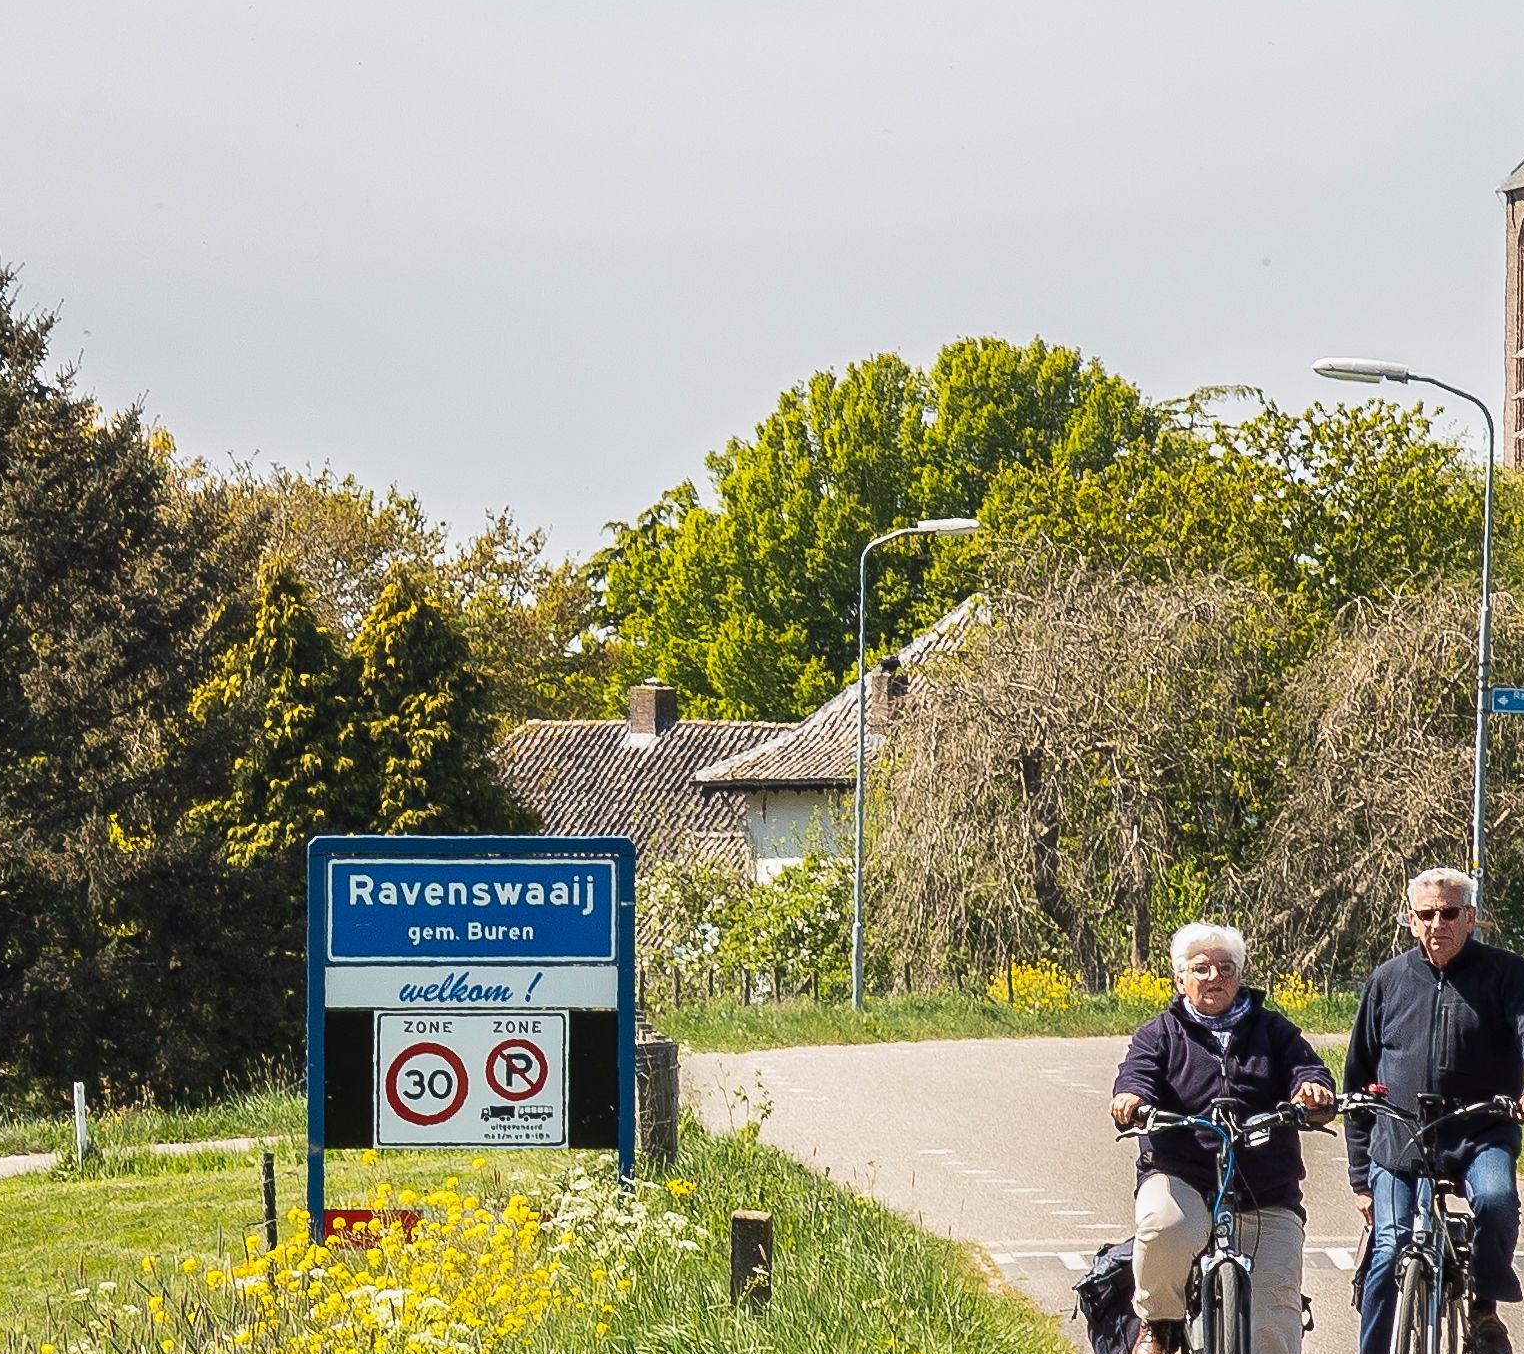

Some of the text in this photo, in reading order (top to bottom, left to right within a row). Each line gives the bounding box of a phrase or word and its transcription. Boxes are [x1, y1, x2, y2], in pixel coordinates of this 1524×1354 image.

[349, 874, 594, 916] Ravenswaaij
[408, 922, 534, 946] gem. Buren
[398, 970, 514, 1004] welkom
[403, 1020, 453, 1034] ZONE
[492, 1020, 542, 1034] ZONE
[402, 1069, 454, 1101] 30
